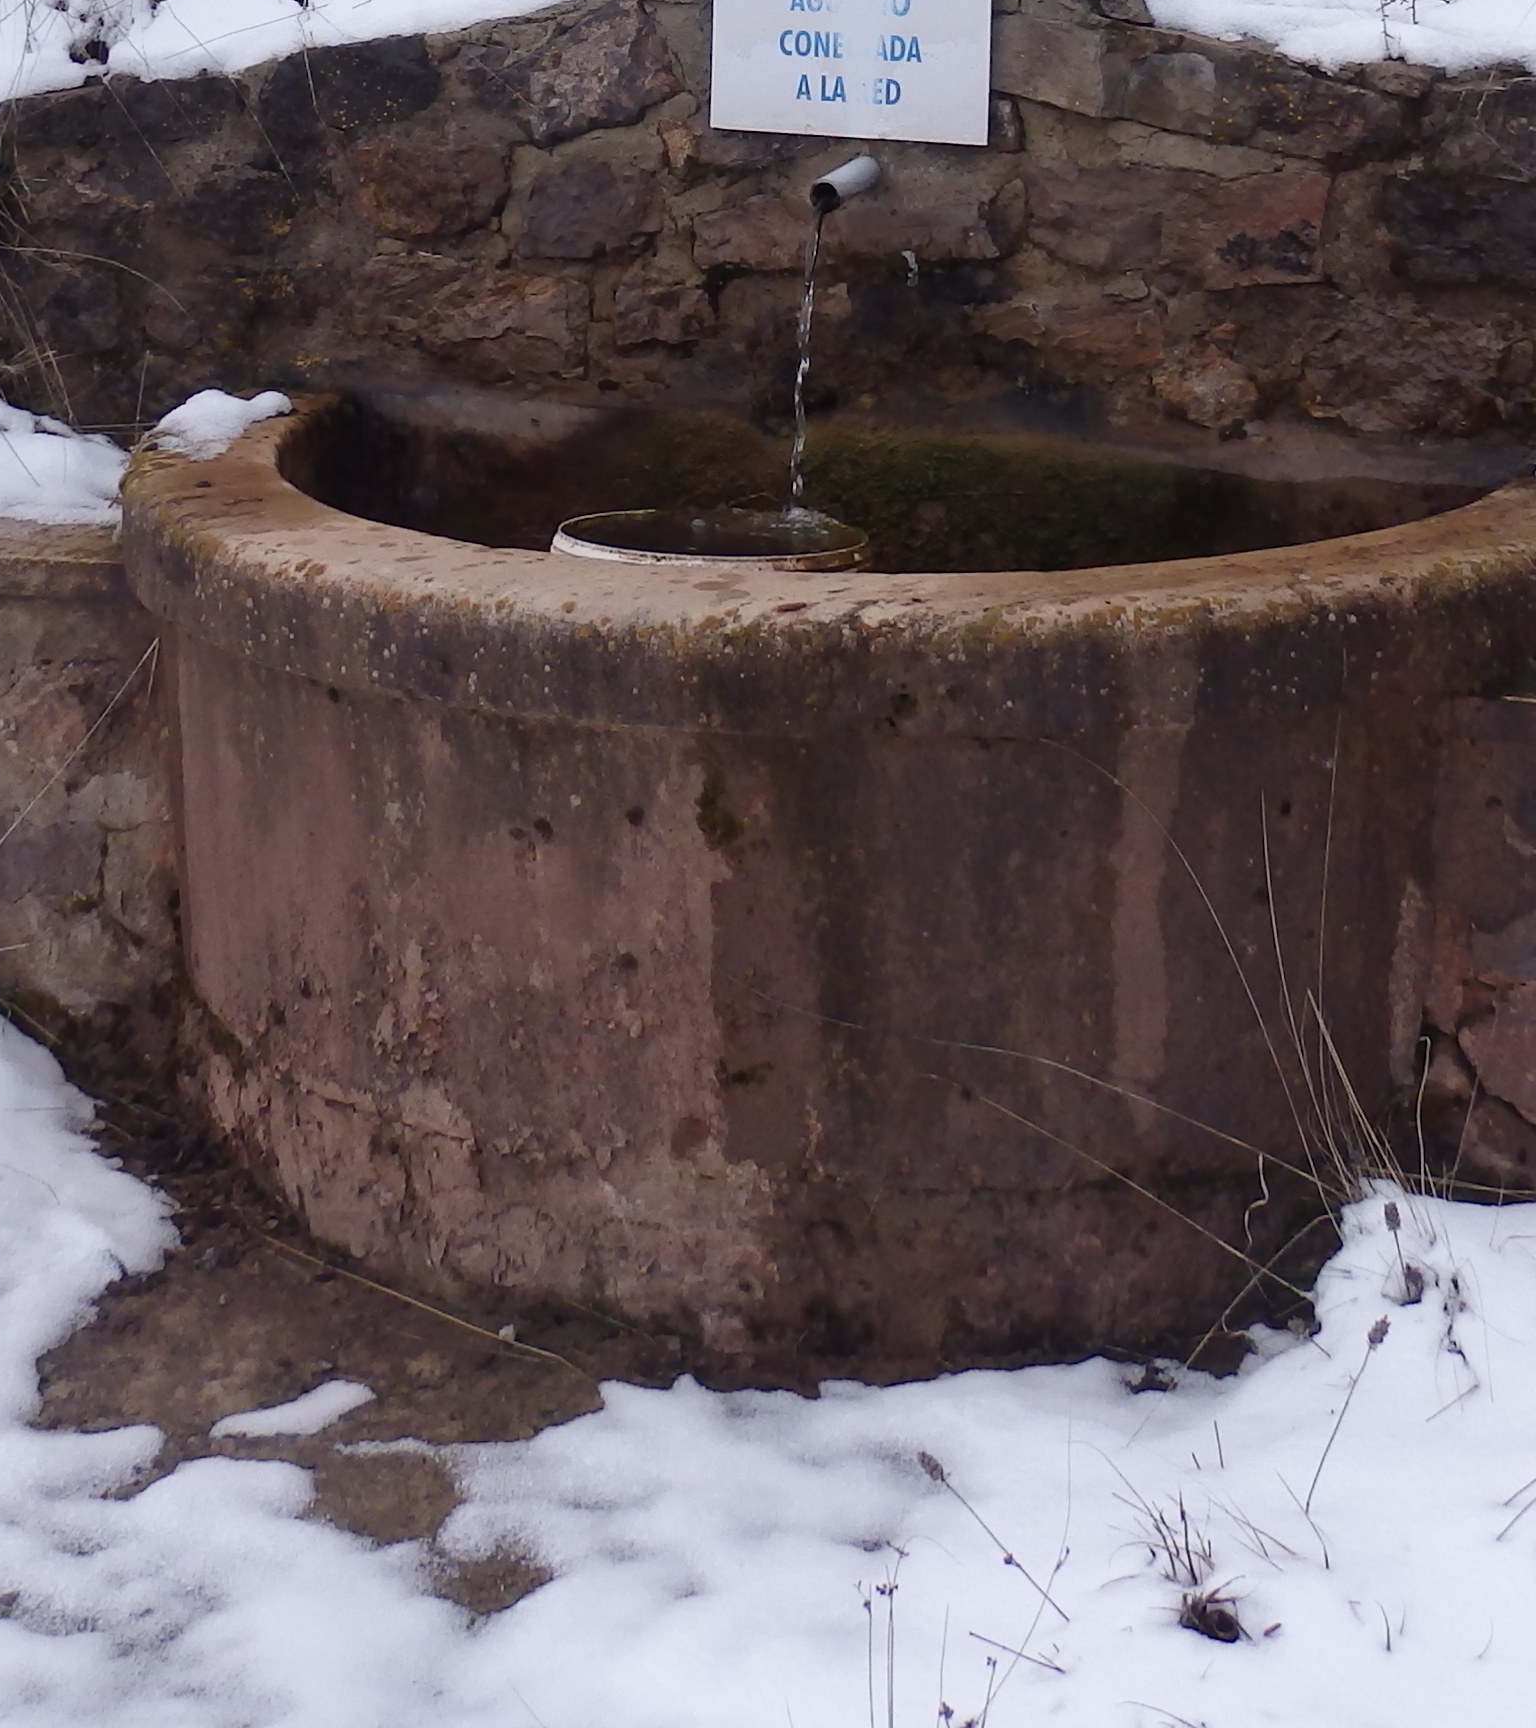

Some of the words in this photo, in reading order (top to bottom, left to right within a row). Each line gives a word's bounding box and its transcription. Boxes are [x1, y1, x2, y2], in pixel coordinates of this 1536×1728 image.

[779, 29, 922, 63] CONEADA
[796, 73, 812, 101] A
[820, 74, 847, 103] LA
[862, 77, 901, 105] ED
